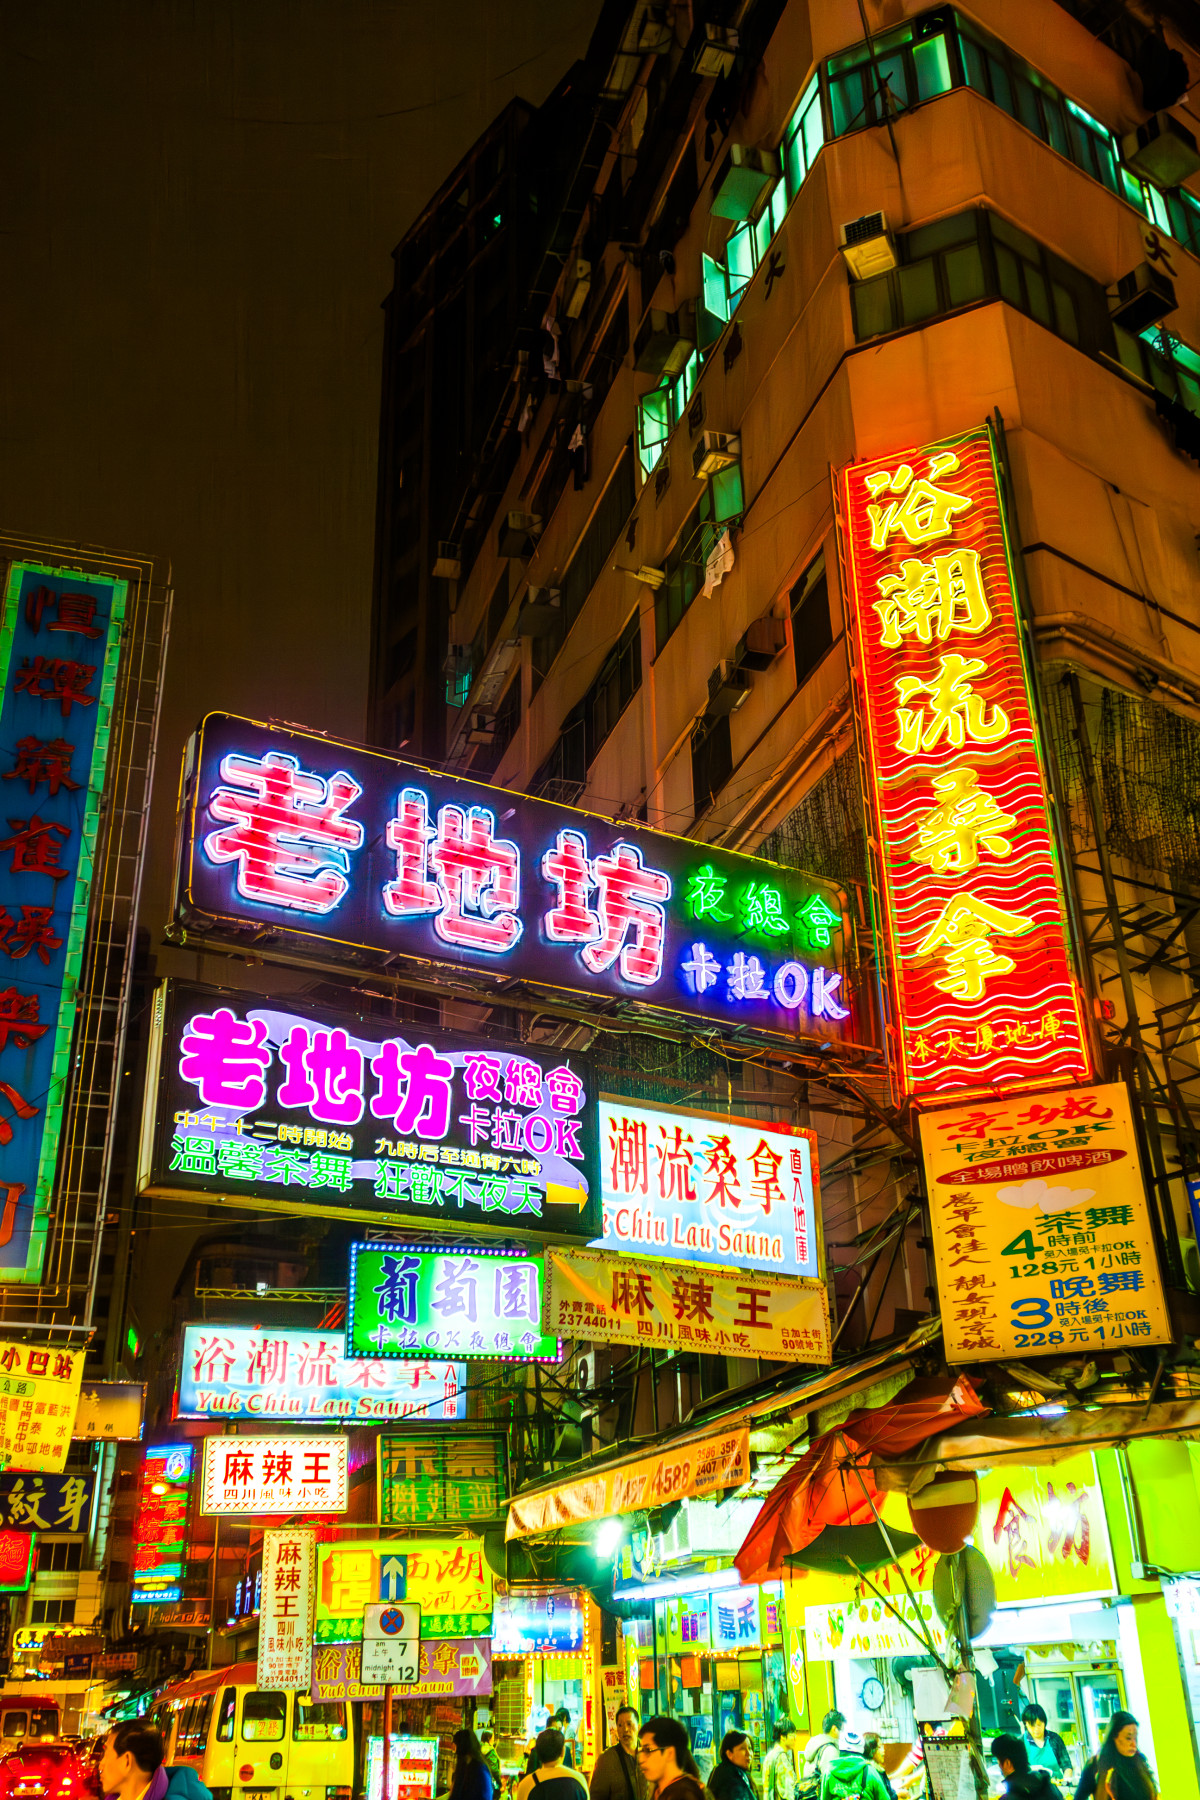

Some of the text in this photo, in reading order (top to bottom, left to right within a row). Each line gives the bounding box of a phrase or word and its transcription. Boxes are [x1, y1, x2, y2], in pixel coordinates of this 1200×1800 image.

[865, 452, 1036, 1000] 浴潮流桑拿
[203, 751, 671, 986] 老地坊
[686, 866, 842, 949] 夜總會
[682, 942, 850, 1021] 卡拉OK
[179, 1008, 454, 1139] 老地坊
[463, 1054, 582, 1114] 夜總會
[173, 1110, 353, 1150] 中午十二時開始
[459, 1103, 584, 1160] 卡拉OK
[937, 1096, 1113, 1141] 京城
[941, 1121, 1115, 1153] 卡拉OK
[963, 1136, 1092, 1162] 夜總會
[169, 1134, 354, 1193] 溫馨茶舞
[609, 1117, 786, 1215] 潮流桑拿
[950, 1150, 1112, 1184] 全場贈飲啤酒
[374, 1159, 543, 1217] 狂歡不夜天
[789, 1148, 809, 1264] 直入地庫
[1035, 1205, 1135, 1235] 茶舞
[615, 1208, 665, 1242] Chiu
[674, 1218, 711, 1248] Lau
[720, 1224, 782, 1260] Sauna
[374, 1255, 539, 1324] 葡萄園
[611, 1269, 773, 1330] 麻辣王
[1049, 1270, 1146, 1299] 晚舞
[559, 1300, 607, 1315] 外賣電話
[559, 1313, 621, 1330] 23744011
[371, 1324, 541, 1353] 卡拉OK夜總會
[637, 1320, 751, 1348] 四川風味小吃
[781, 1328, 821, 1340] 白加士街
[1, 1347, 73, 1379] 小巴站
[199, 1391, 428, 1417] Yuk Chiu Lau Sauna
[223, 1450, 331, 1486] 麻辣王
[652, 1460, 690, 1497] 4588
[8, 1477, 89, 1532] 紋身
[223, 1487, 330, 1501] 四川風味小吃
[993, 1482, 1090, 1578] 食坊
[273, 1540, 302, 1618] 麻辣王
[406, 1546, 485, 1585] 西湖
[160, 1612, 179, 1624] hair
[180, 1612, 211, 1624] salon
[277, 1621, 295, 1636] 四川
[267, 1636, 304, 1653] 風味小吃
[372, 1649, 388, 1657] 上午
[398, 1642, 408, 1657] 7
[265, 1675, 303, 1684] 23744011
[365, 1664, 394, 1672] midnight
[398, 1666, 415, 1681] 12
[319, 1682, 346, 1699] Yuk
[347, 1682, 381, 1697] Chiu
[411, 1681, 454, 1695] Sauna
